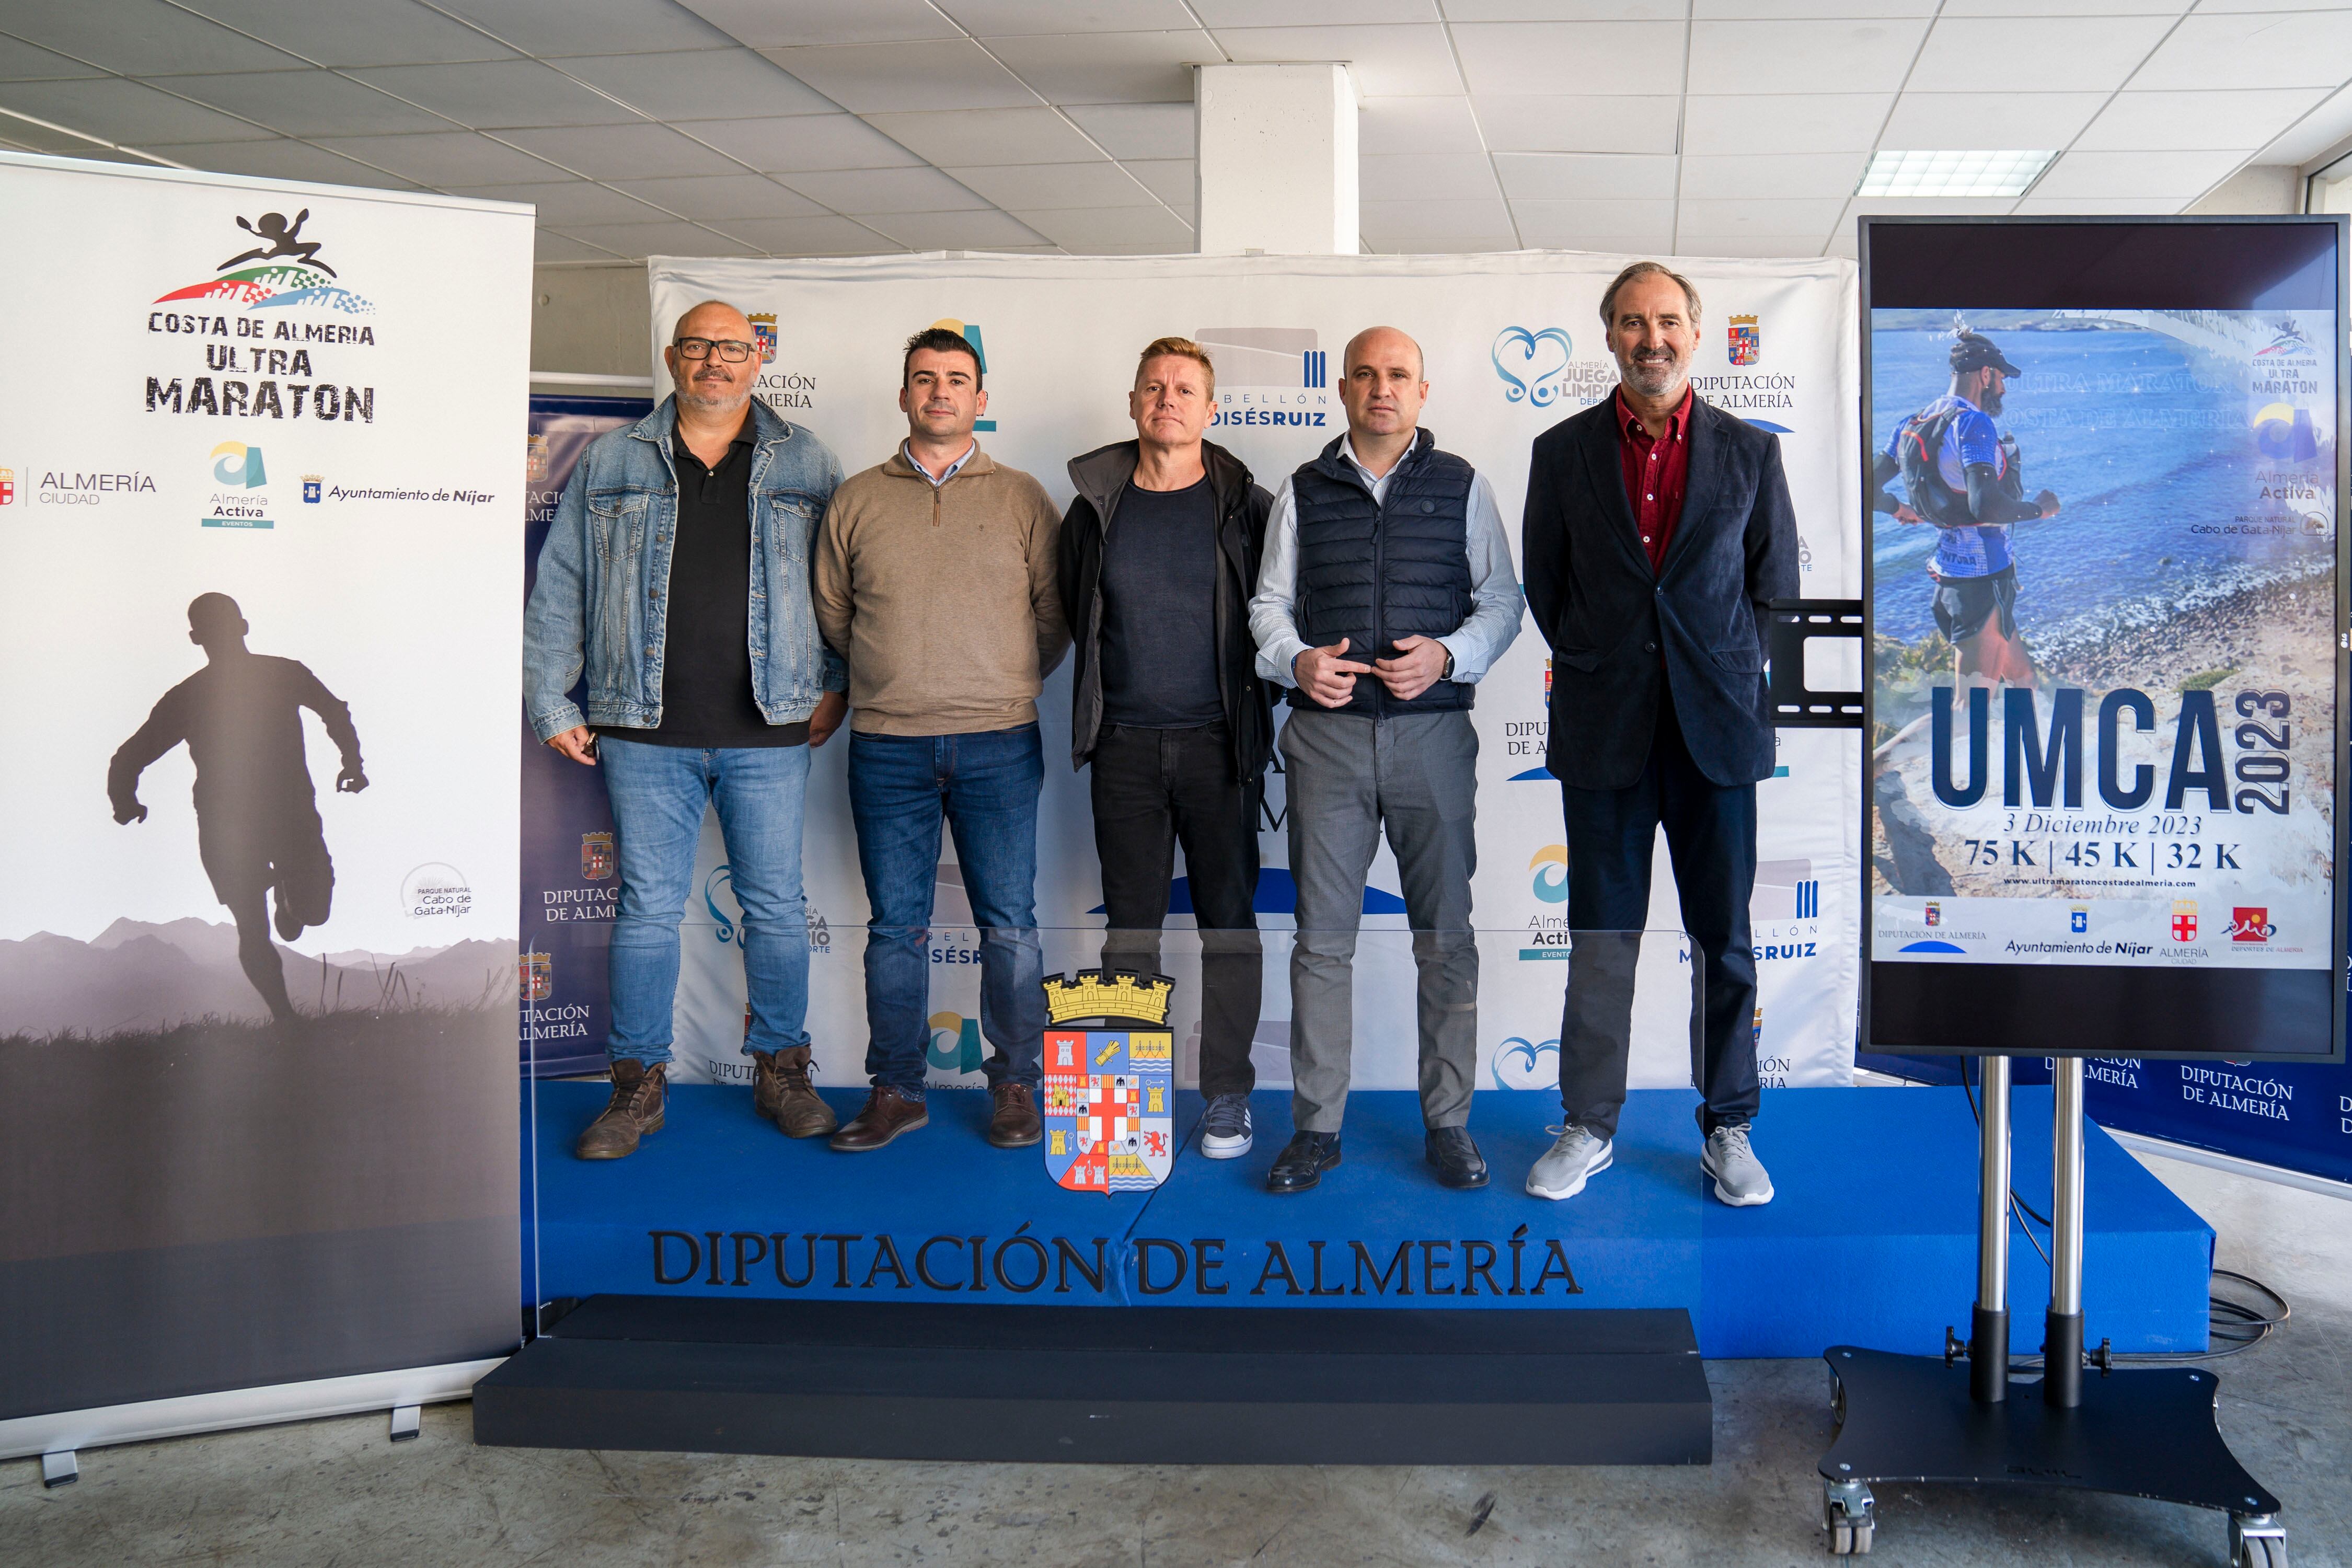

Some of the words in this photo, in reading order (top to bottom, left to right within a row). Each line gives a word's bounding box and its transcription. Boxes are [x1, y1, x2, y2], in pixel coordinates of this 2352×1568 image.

[148, 312, 228, 336] COSTA
[237, 317, 264, 339] DE
[273, 321, 375, 345] ALMERIA
[206, 344, 313, 377] ULTRA
[1568, 360, 1609, 369] ALMERÍA
[753, 372, 816, 390] ACIÓN
[1563, 368, 1619, 384] JUEGA
[1690, 372, 1795, 390] DIPUTACIÓN
[2268, 368, 2300, 379] ULTRA
[2252, 381, 2318, 394] MARATON
[146, 376, 374, 423] MARATON
[759, 391, 813, 408] MERÍA
[1224, 393, 1326, 404] BELLÓN
[1720, 391, 1793, 408] ALMERÍA
[1210, 407, 1325, 426] OISÉSRUIZ
[40, 471, 156, 492] ALMERÍA
[2255, 470, 2319, 484] Almería
[39, 492, 100, 505] CIUDAD
[210, 493, 268, 505] Almería
[328, 485, 429, 501] Ayuntamiento
[432, 488, 449, 501] de
[453, 490, 495, 505] Níjar
[2259, 486, 2315, 499] Activa
[213, 506, 263, 517] Activa
[2191, 524, 2220, 534] Cabo
[2223, 524, 2238, 534] de
[1507, 741, 1530, 755] DE
[1931, 686, 2232, 813] UMCA
[2235, 688, 2291, 815] 2023
[2003, 813, 2015, 832] 3
[2024, 813, 2140, 835] Diciembre
[2148, 815, 2202, 835] 2023
[1964, 839, 1999, 867] 75
[2011, 840, 2038, 867] K
[2065, 841, 2100, 868] 45
[2113, 841, 2140, 868] K
[2166, 843, 2202, 869] 32
[2215, 843, 2242, 870] K
[2003, 877, 2196, 887] www.ultramaratoncostadealmeria.com
[423, 895, 453, 904] Cabo
[457, 894, 471, 903] de
[544, 887, 618, 904] DIPUTAC
[546, 908, 569, 921] DE
[1532, 931, 1567, 945] Acti
[1878, 928, 1933, 939] DIPUTACIÓN
[1934, 930, 1945, 939] DE
[1948, 929, 1987, 940] ALMERÍA
[2005, 939, 2094, 955] Ayuntamiento
[2096, 941, 2112, 954] de
[2115, 940, 2153, 958] Níjar
[2160, 946, 2208, 958] ALMERÍA
[519, 1004, 590, 1022] TACIÓN
[519, 1020, 589, 1041] LMERÍA
[2085, 1065, 2139, 1089] MERÍA
[2181, 1065, 2293, 1100] DIPUTACIÓN
[2183, 1085, 2204, 1103] DE
[2209, 1091, 2290, 1121] ALMERÍA
[647, 1220, 1110, 1294] DIPUTACIÓN
[1132, 1238, 1229, 1295] DE
[1249, 1223, 1584, 1296] ALMERÍA
